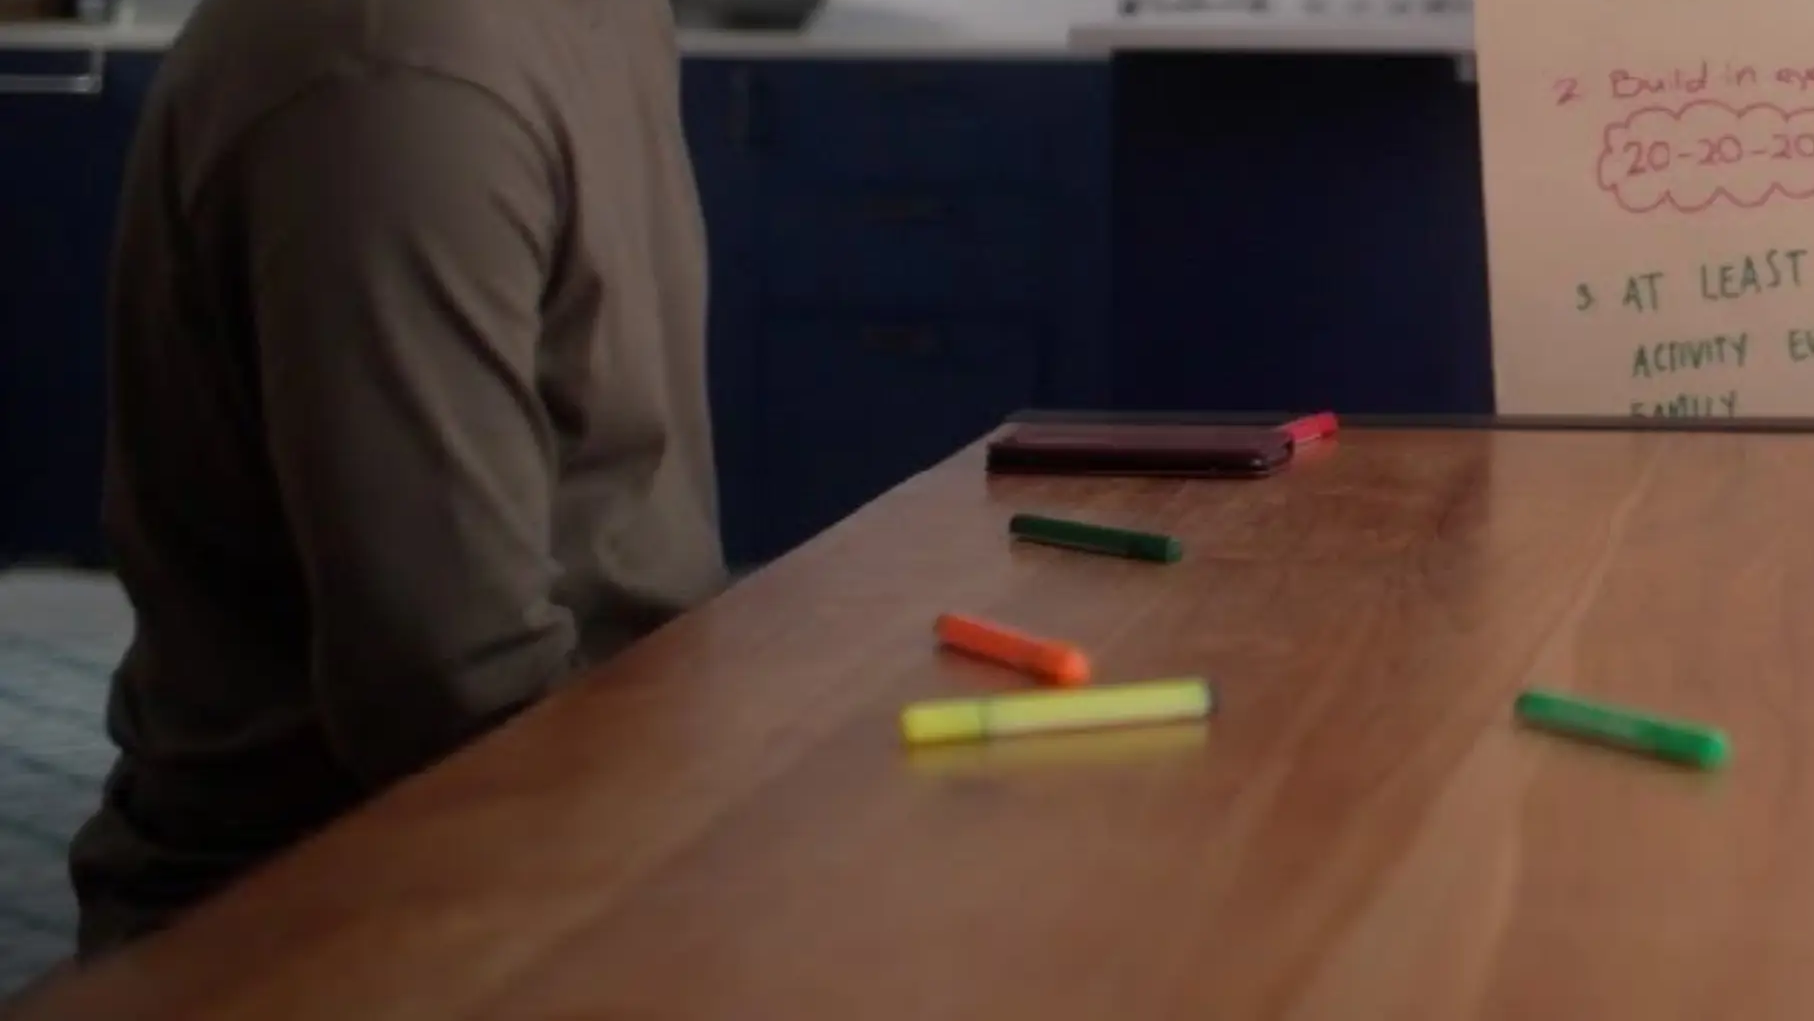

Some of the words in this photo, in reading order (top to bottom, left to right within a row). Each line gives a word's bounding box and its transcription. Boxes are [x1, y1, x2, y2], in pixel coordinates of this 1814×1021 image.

[1608, 60, 1708, 98] Build
[1726, 61, 1757, 87] in
[1622, 271, 1664, 313] AT
[1701, 249, 1808, 301] LEAST
[1632, 332, 1749, 378] ACTIVITY
